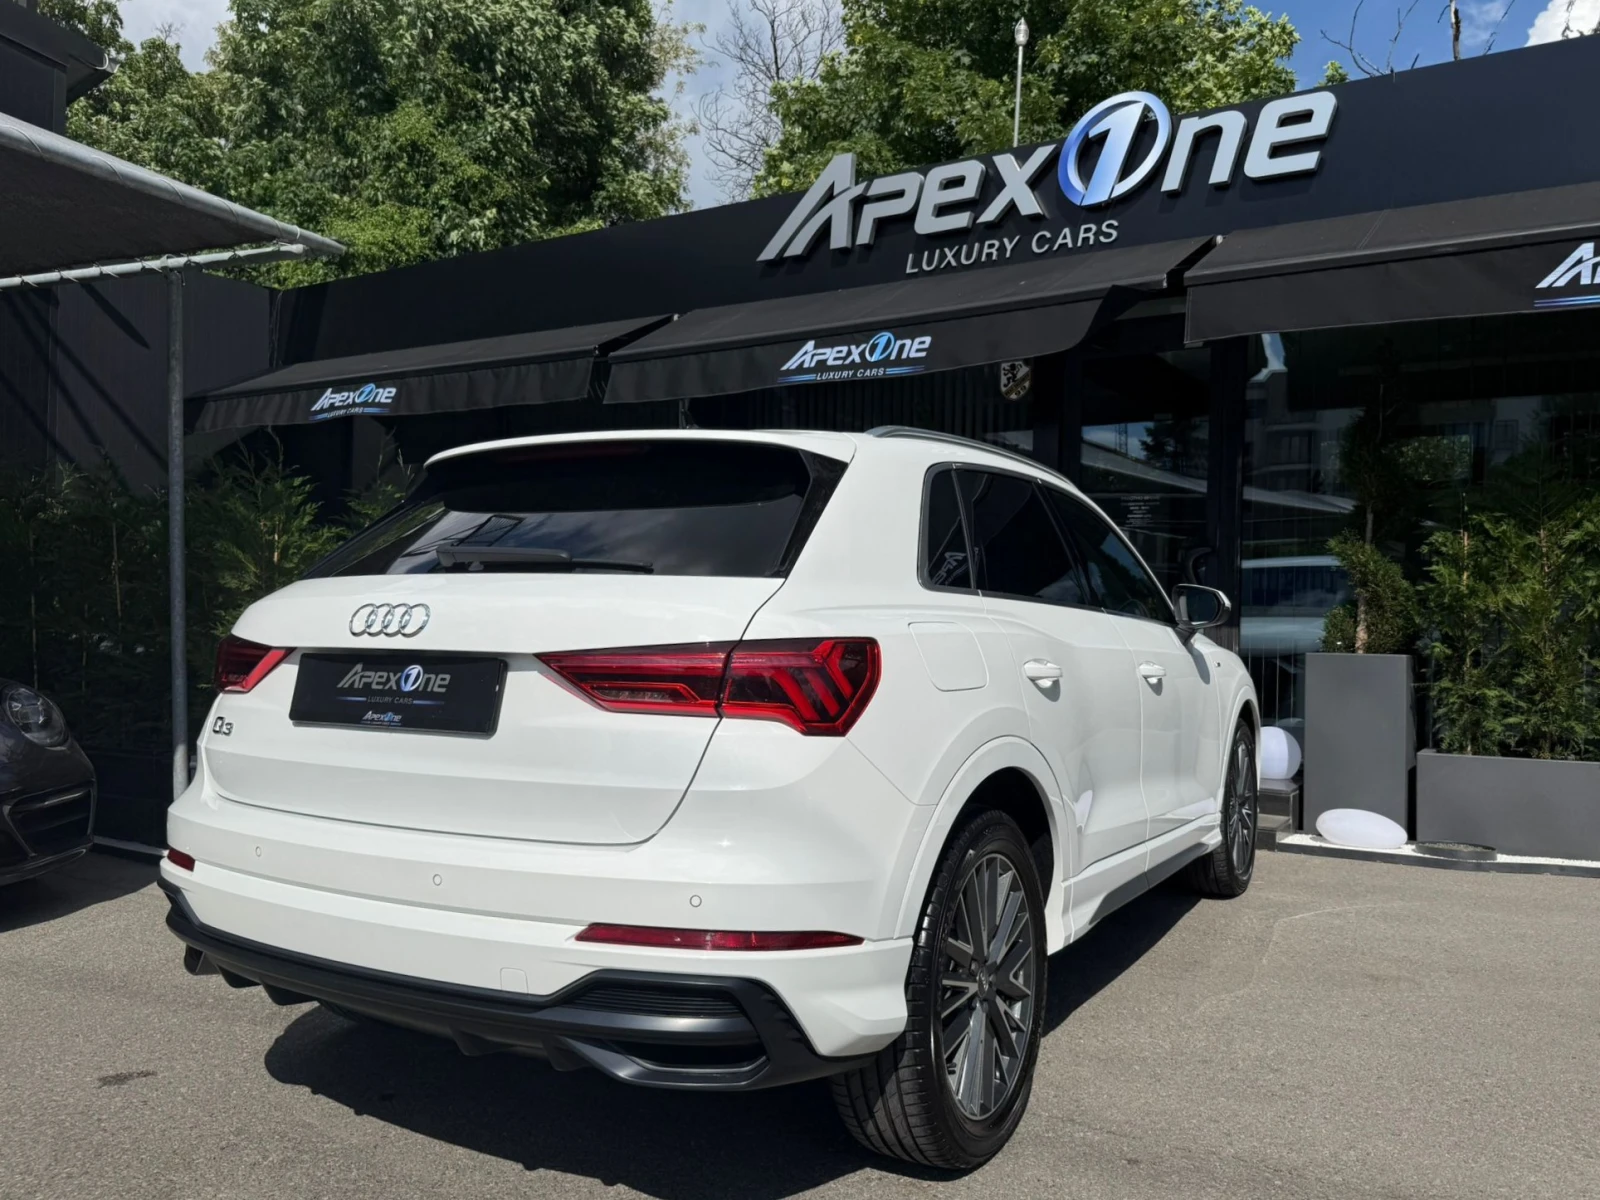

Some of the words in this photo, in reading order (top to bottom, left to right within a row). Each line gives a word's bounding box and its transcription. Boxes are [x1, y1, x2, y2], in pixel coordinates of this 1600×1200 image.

[906, 235, 1020, 274] LUXURY
[1031, 219, 1119, 254] CARS
[816, 370, 854, 380] LUXURY
[857, 367, 884, 378] CARS
[367, 695, 393, 704] LUXURY
[394, 697, 414, 705] CARS
[212, 716, 234, 736] Q3
